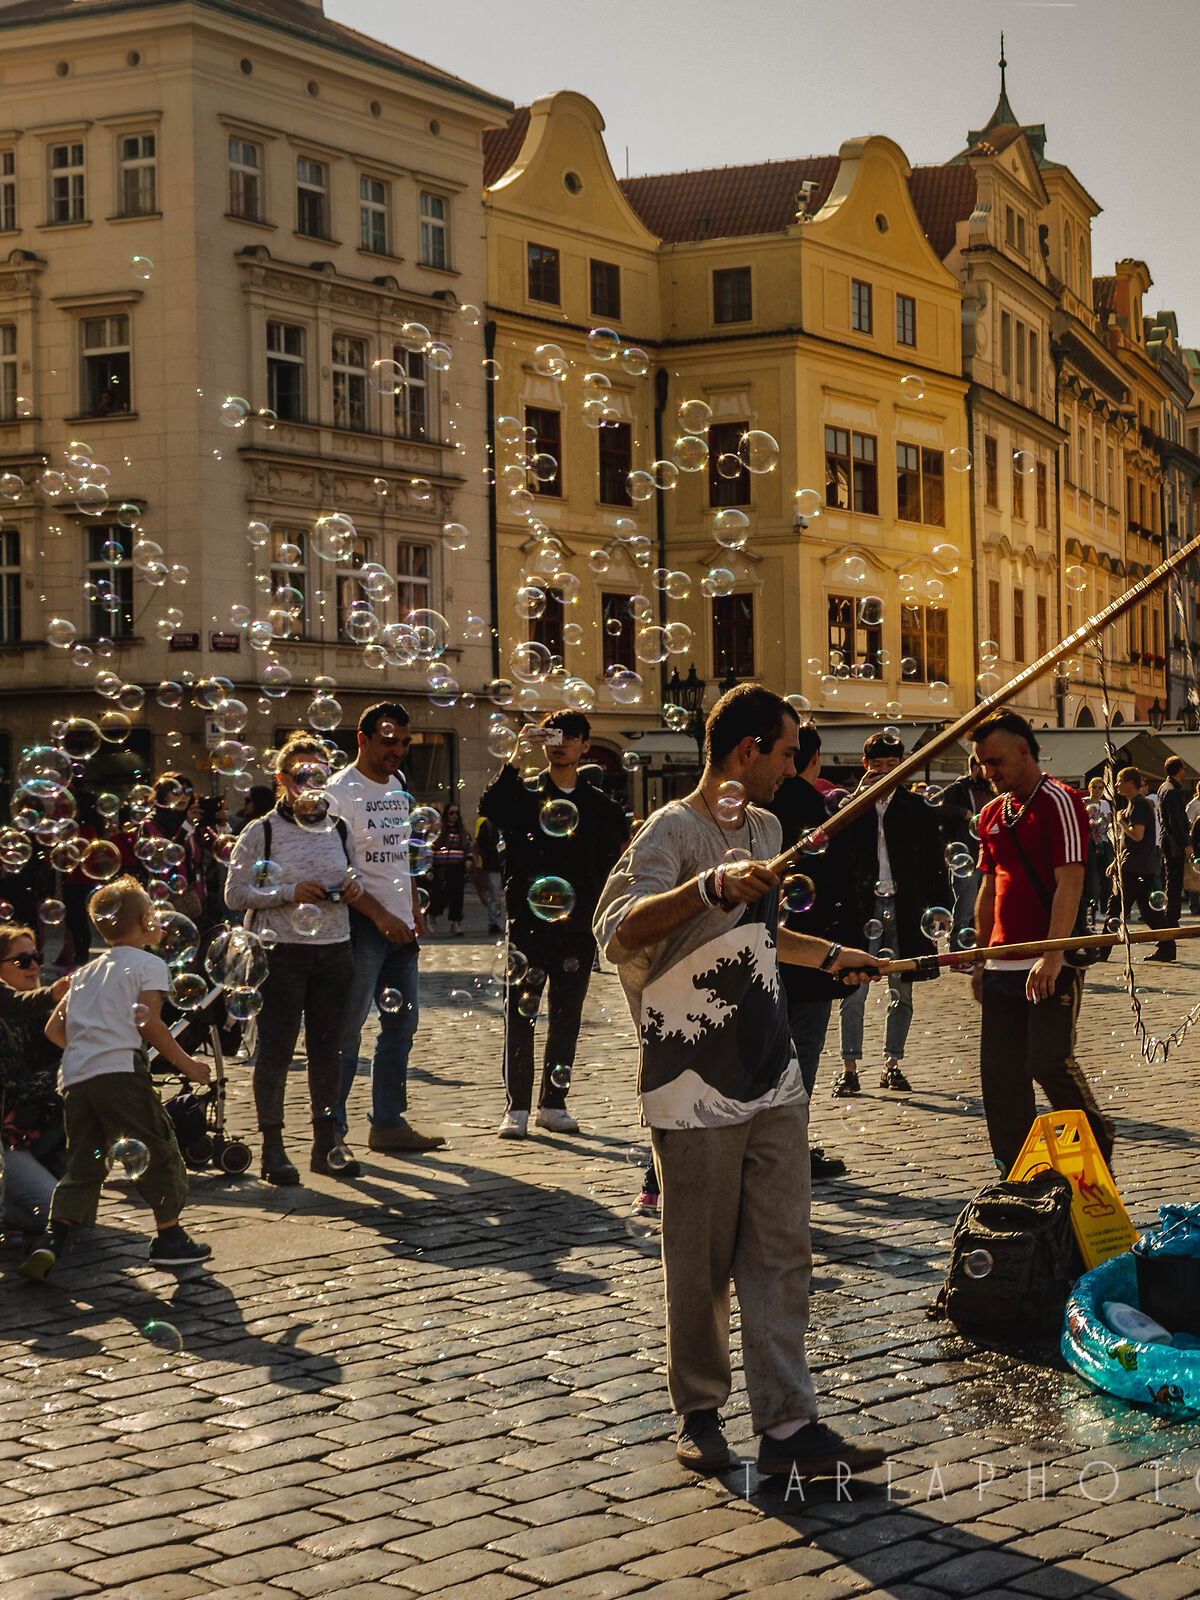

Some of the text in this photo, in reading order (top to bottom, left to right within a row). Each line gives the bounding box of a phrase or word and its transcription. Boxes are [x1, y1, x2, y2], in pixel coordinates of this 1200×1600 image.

[365, 800, 402, 812] SUCCESS
[367, 818, 376, 829] A
[383, 834, 400, 845] NOT
